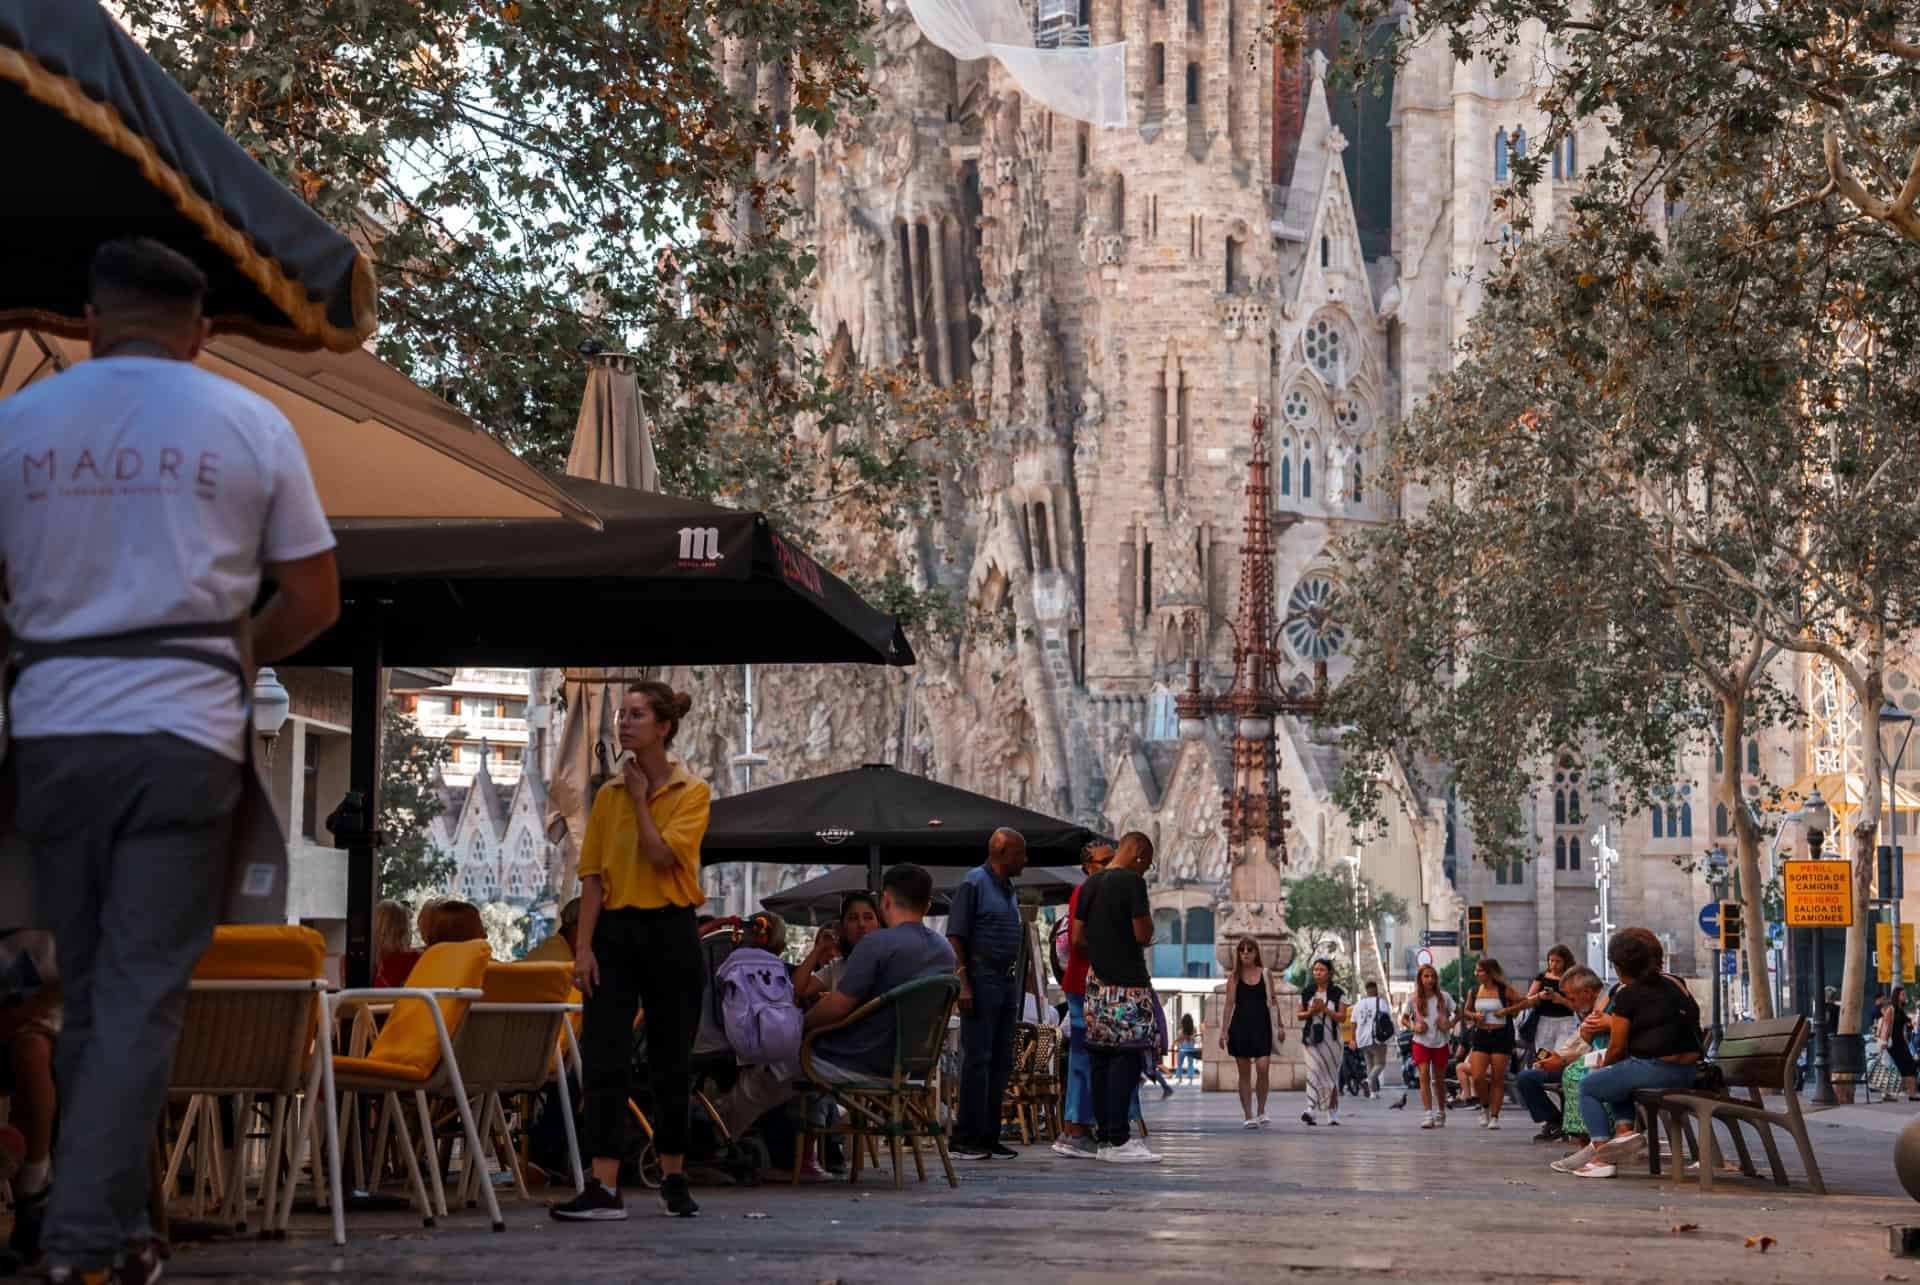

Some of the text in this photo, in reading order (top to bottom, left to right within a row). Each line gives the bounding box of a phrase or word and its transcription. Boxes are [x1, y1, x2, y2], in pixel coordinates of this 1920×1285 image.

[22, 446, 223, 487] MADRE
[1800, 864, 1832, 872] PERILL
[1798, 896, 1839, 904] PELIGRO
[1794, 905, 1844, 913] SALIDA DE
[1794, 914, 1844, 922] CAMIONES
